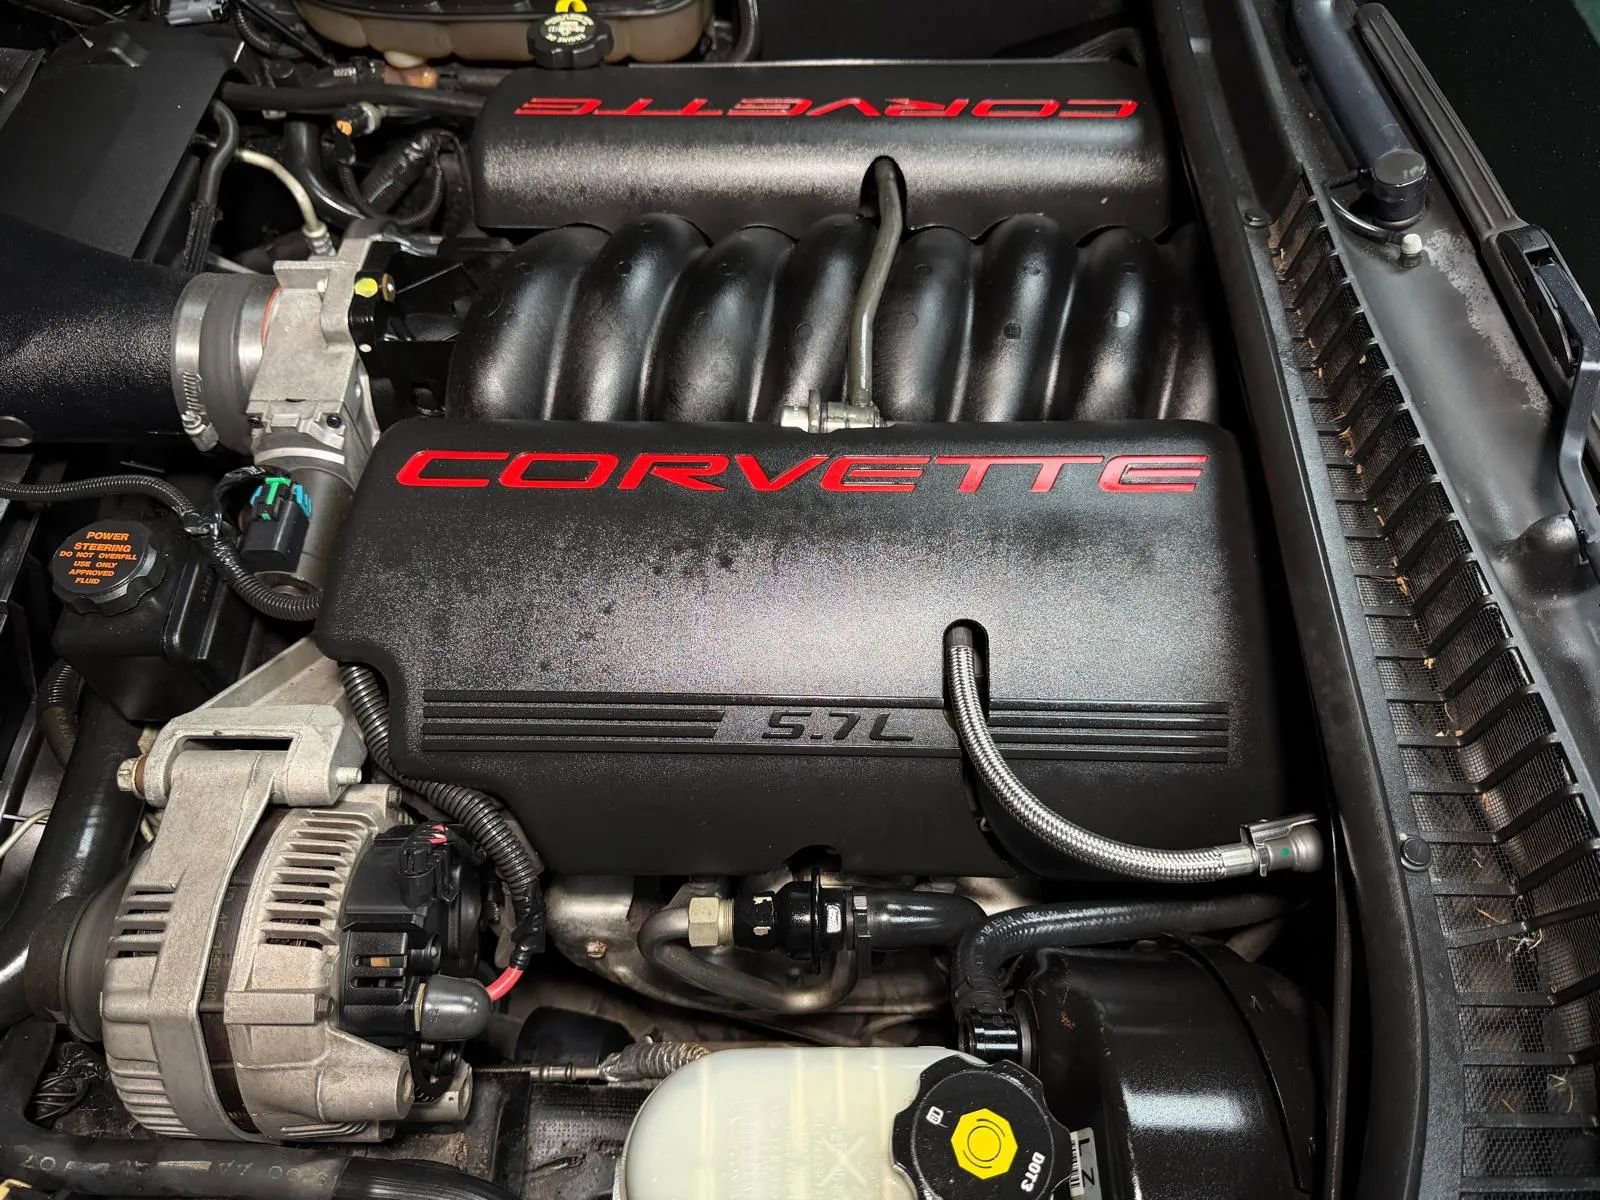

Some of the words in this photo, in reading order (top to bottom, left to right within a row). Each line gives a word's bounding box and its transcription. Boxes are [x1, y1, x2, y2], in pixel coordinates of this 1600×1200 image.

[514, 97, 1138, 119] CORVETTE
[395, 449, 1208, 494] CORVETTE
[86, 531, 129, 540] POWER
[74, 542, 131, 552] STEERING
[75, 551, 95, 559] NOT
[761, 709, 915, 742] 5.7L
[1020, 1152, 1046, 1192] DOT3
